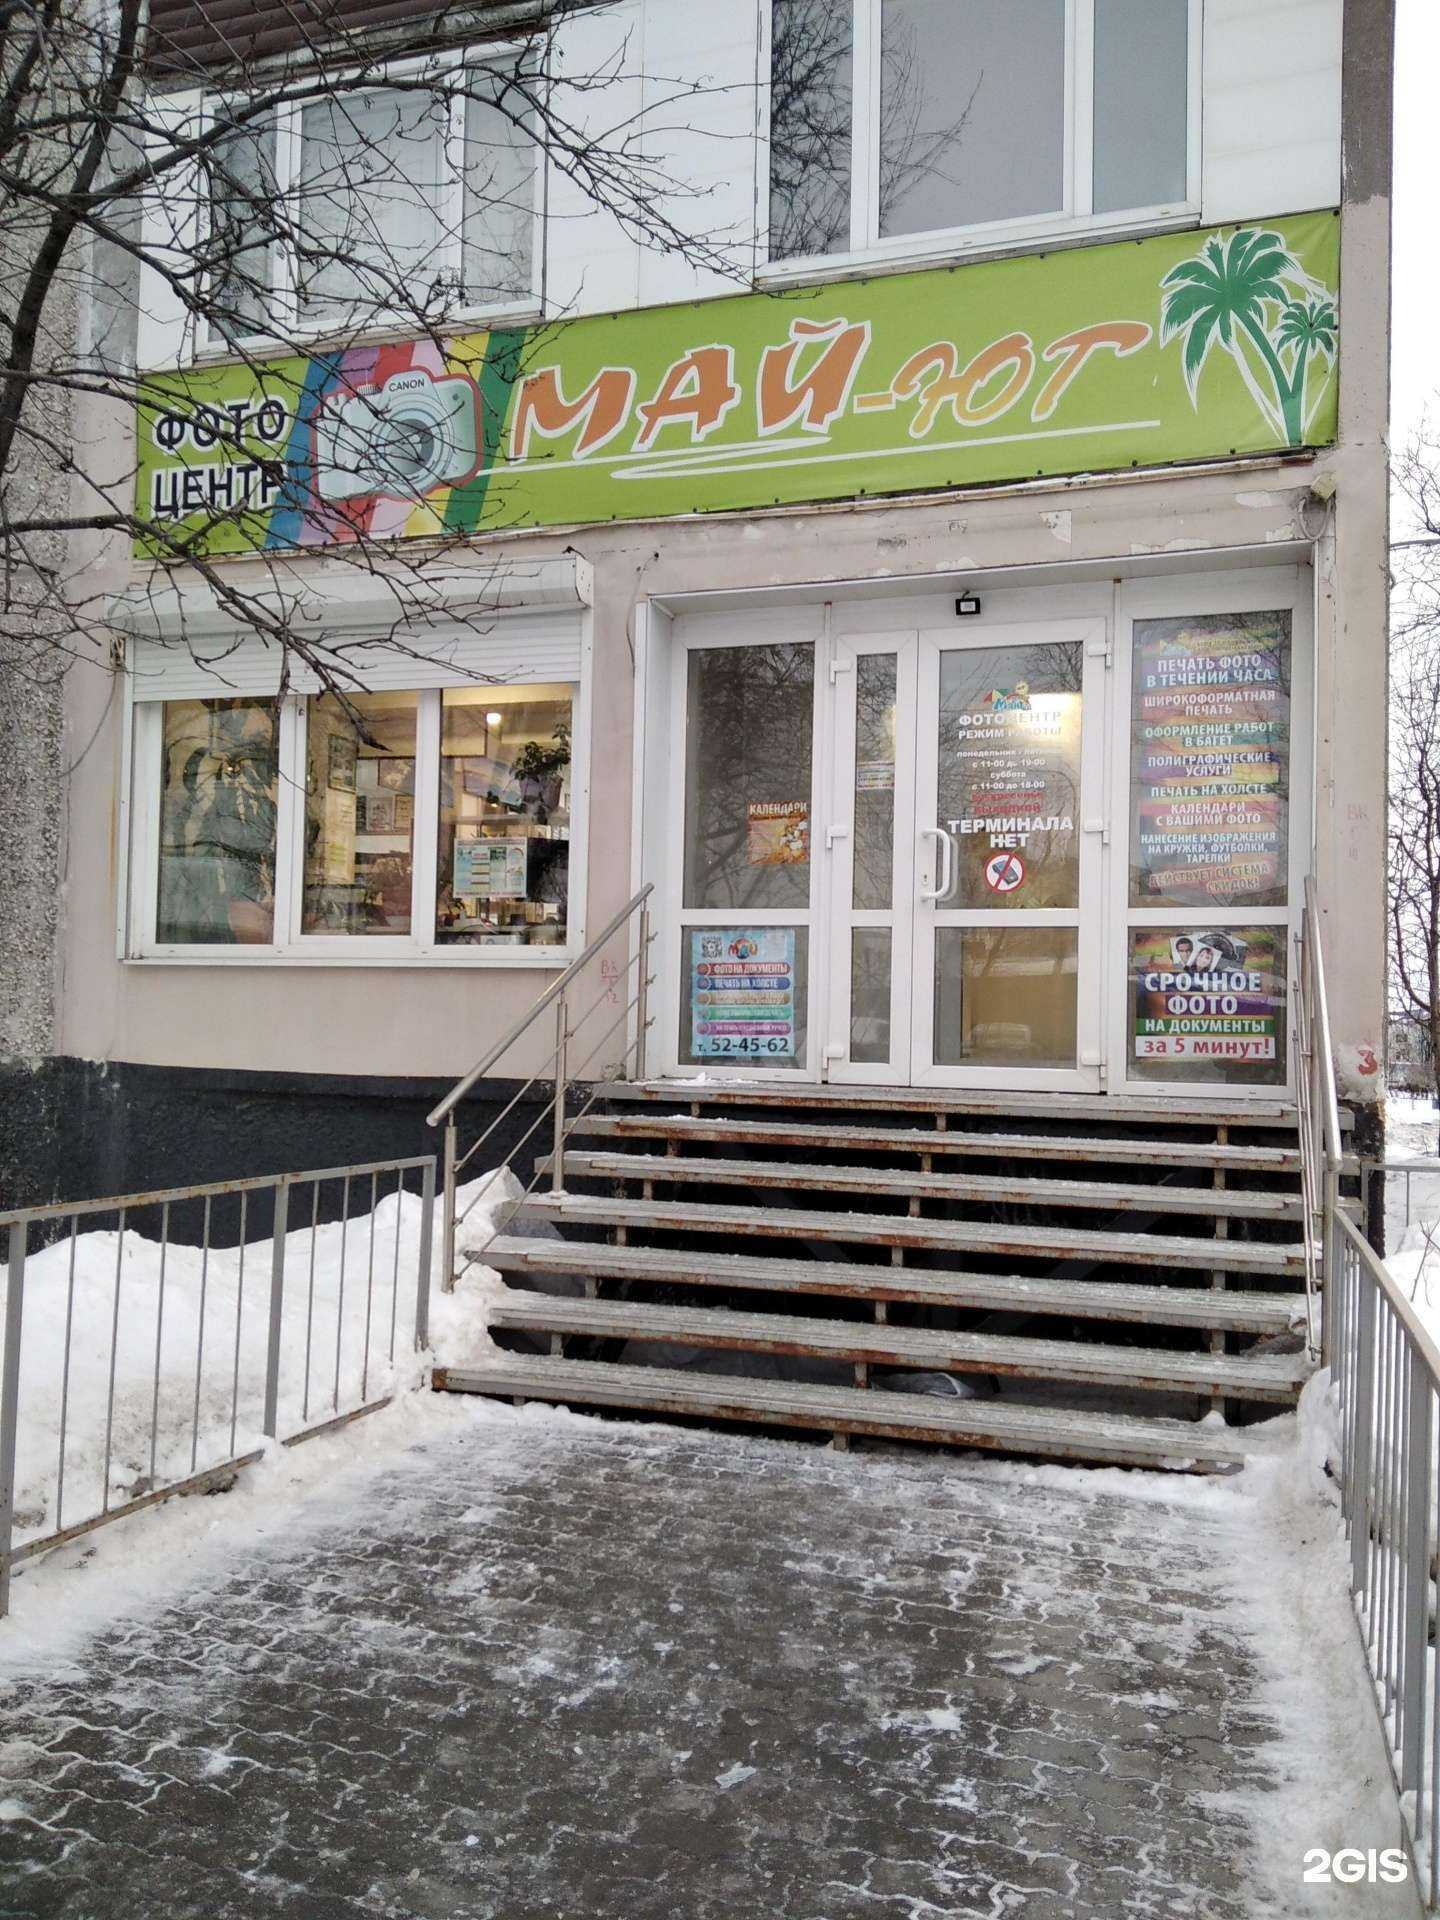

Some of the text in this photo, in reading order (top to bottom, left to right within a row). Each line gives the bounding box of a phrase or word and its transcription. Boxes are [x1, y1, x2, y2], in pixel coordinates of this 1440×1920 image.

[388, 377, 425, 392] CANON
[154, 397, 287, 453] ФОТО
[153, 461, 286, 519] ЦЕНТР
[1158, 654, 1261, 673] ПЕЧАТЬ ФОТО
[1147, 668, 1272, 688] В ТЕЧЕНИИ ЧАСА
[1144, 690, 1276, 707] ШИРОКОФОРМАТНАЯ
[1186, 704, 1233, 716] ПЕЧАТЬ
[958, 729, 1004, 740] РЕЖИМ
[1145, 722, 1274, 738] ОФОРМЛЕНИЕ РАБОТ
[1185, 736, 1234, 747] В БАГЕТ
[1148, 752, 1271, 767] ПОЛИГРАФИЧЕСКИЕ
[991, 772, 1026, 780] суббота
[1186, 765, 1231, 777] УСЛУГИ
[1151, 784, 1267, 797] ПЕЧАТЬ НА ХОЛСТЕ
[750, 802, 807, 815] КАЛЕНДАРИ
[1171, 802, 1246, 815] КАЛЕНДАРИ
[947, 817, 1074, 834] ТЕРМИНАЛА
[1156, 813, 1261, 826] С ВАШИМИ ФОТО
[990, 833, 1030, 849] НЕТ
[1141, 831, 1276, 844] НАНЕСЕНИЕ ИЗОБРАЖЕНИЯ
[1148, 844, 1161, 854] НА
[1186, 854, 1231, 864] ТАРЕЛКИ
[714, 965, 733, 974] ФОТО
[744, 963, 788, 974] ДОКУМЕНТЫ
[1144, 972, 1262, 992] СРОЧНОЕ
[1167, 995, 1238, 1015] ФОТО
[1145, 1020, 1265, 1034] НА ДОКУМЕНТЫ
[697, 1037, 789, 1052] т. 52-45-62
[1144, 1038, 1270, 1058] за 5 минут!
